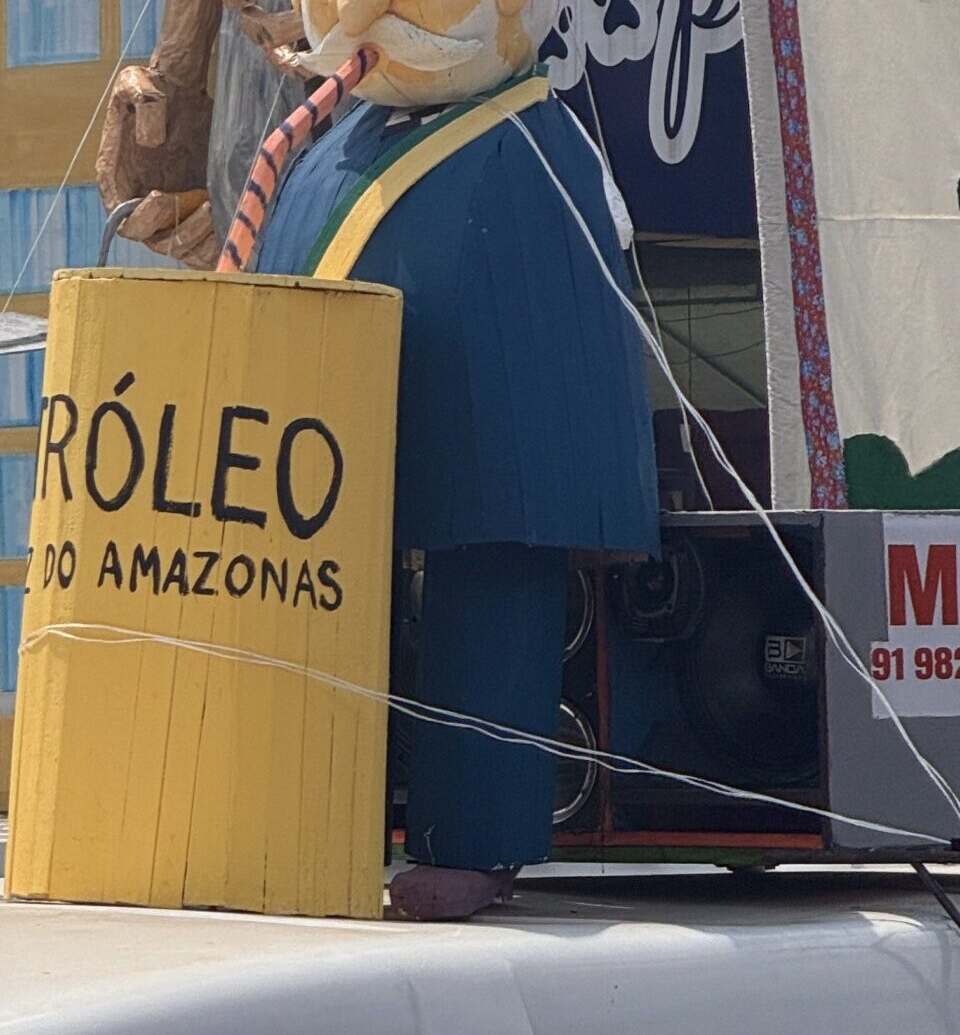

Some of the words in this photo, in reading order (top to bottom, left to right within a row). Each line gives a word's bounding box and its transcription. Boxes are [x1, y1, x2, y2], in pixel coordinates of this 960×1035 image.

[39, 371, 344, 541] RÓLEO
[42, 540, 77, 590] DO
[97, 540, 344, 612] AMAZONAS
[871, 647, 904, 681] 91
